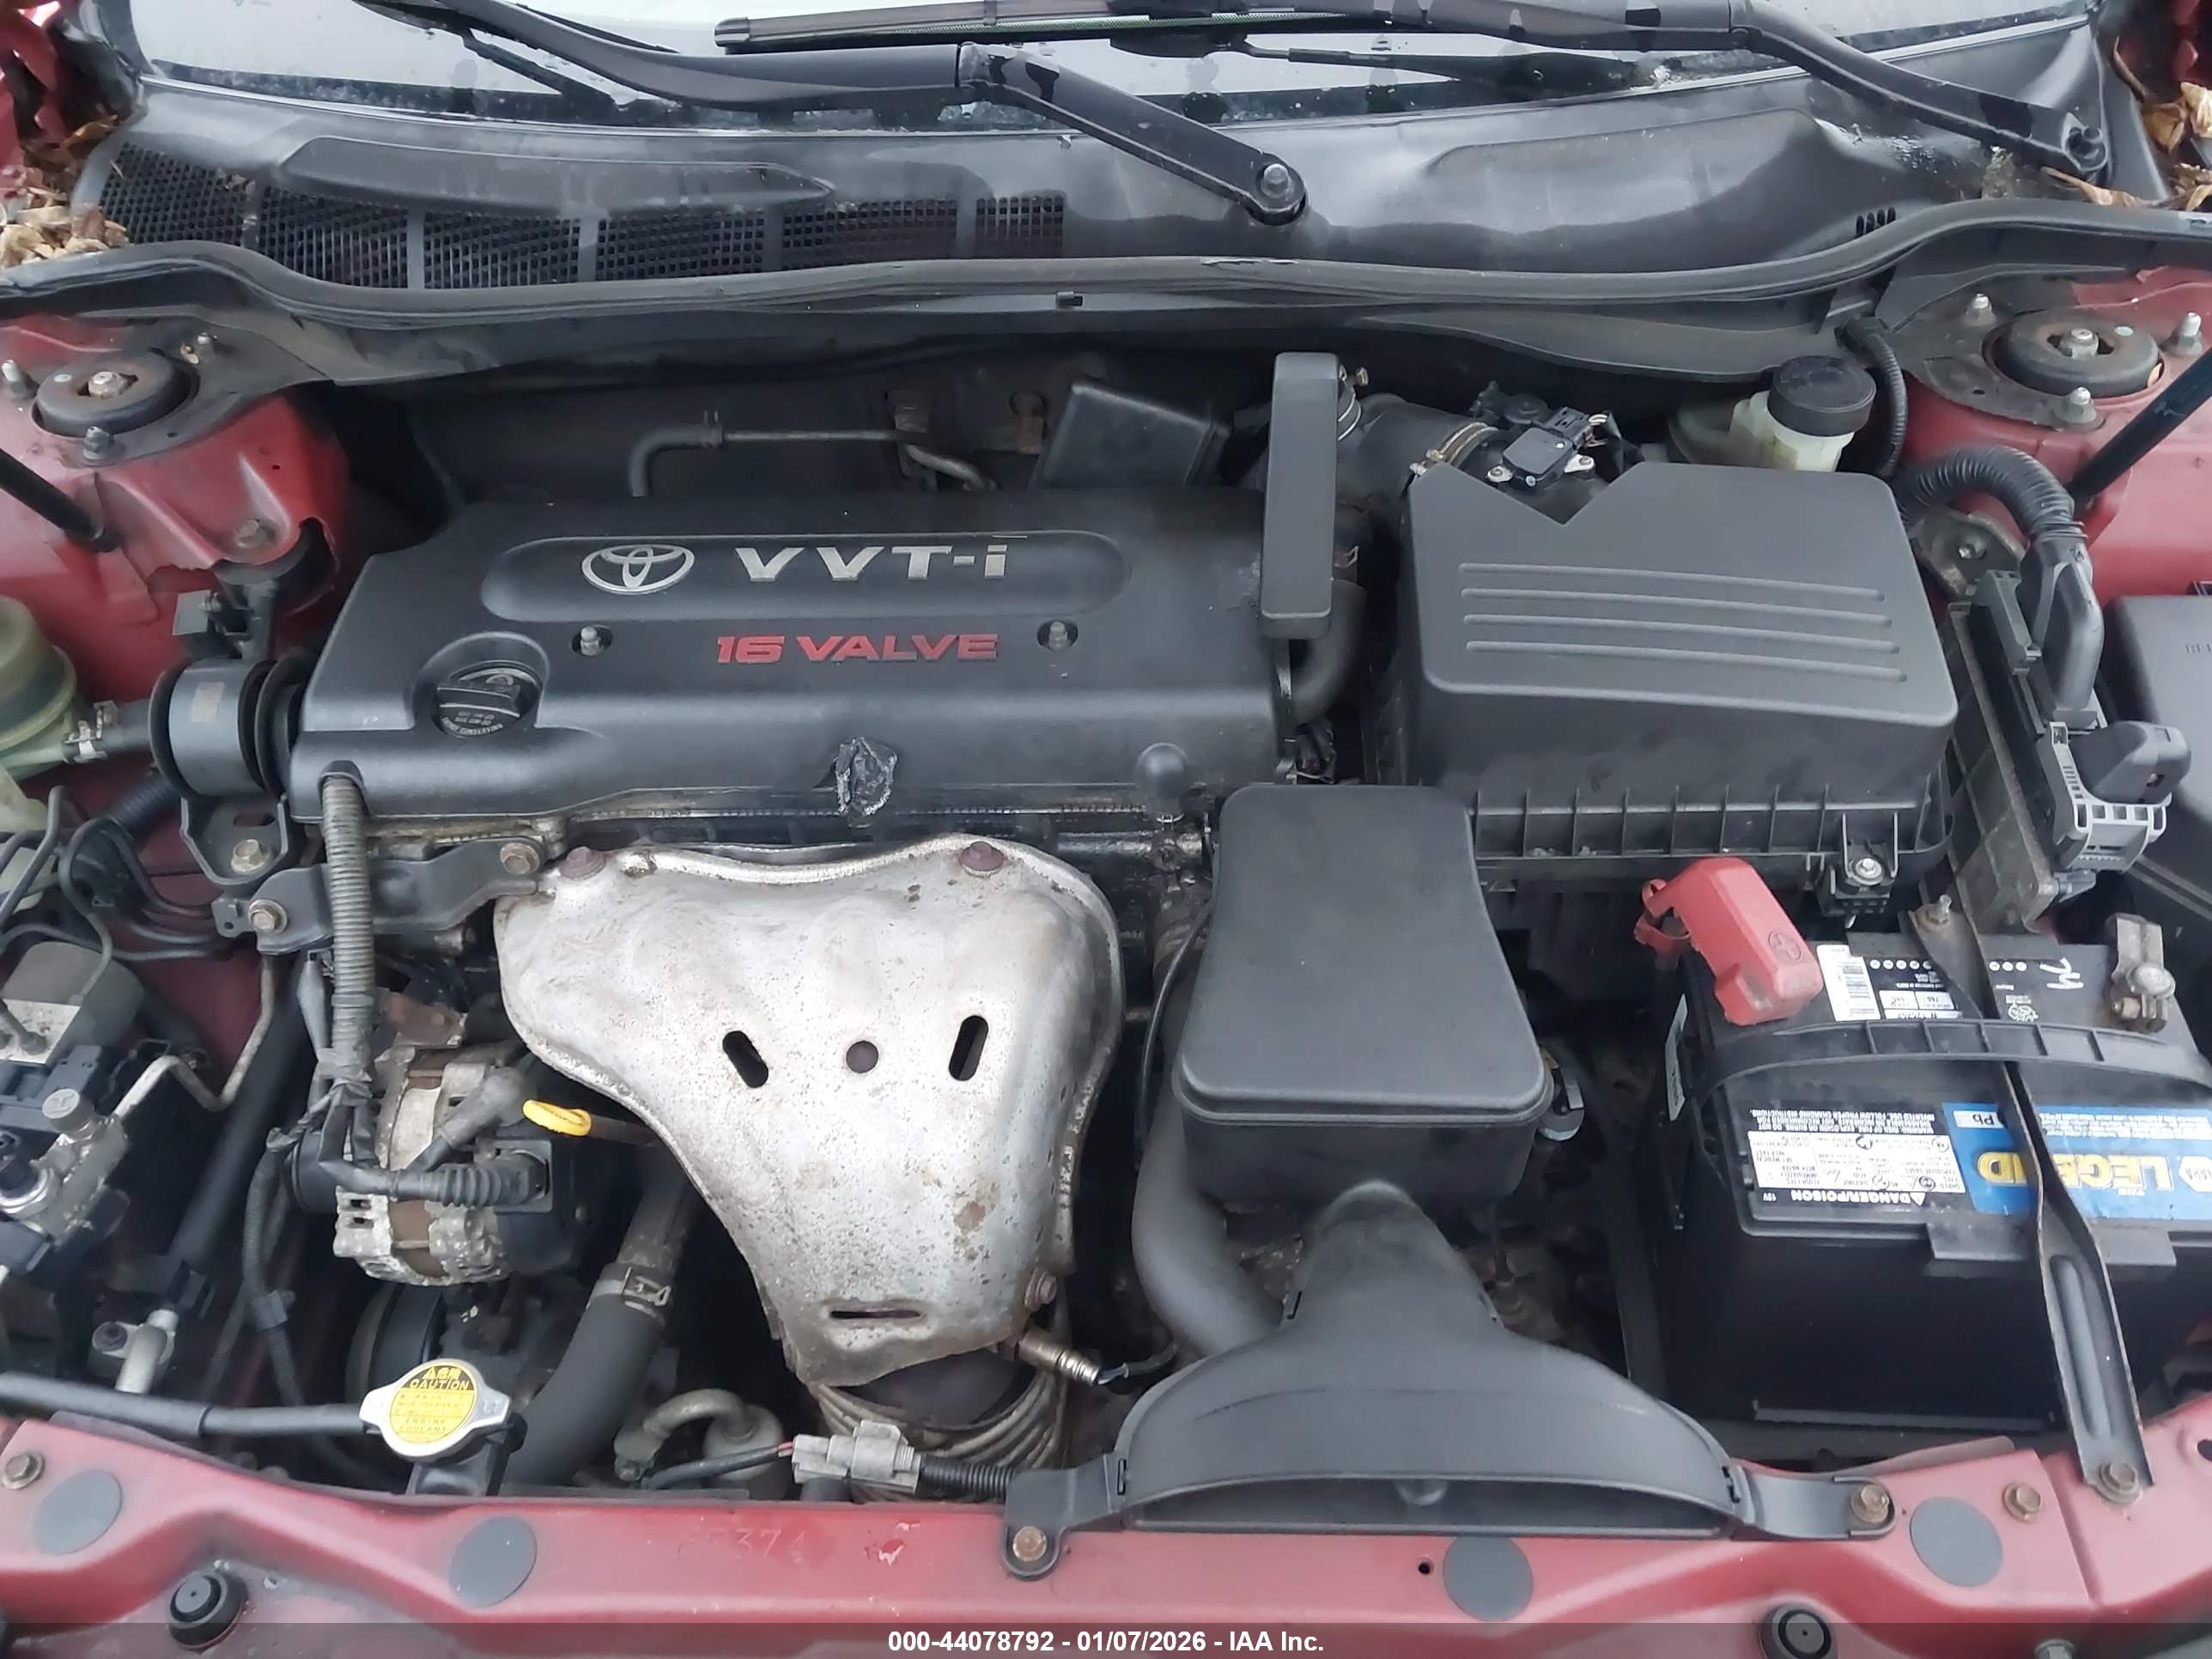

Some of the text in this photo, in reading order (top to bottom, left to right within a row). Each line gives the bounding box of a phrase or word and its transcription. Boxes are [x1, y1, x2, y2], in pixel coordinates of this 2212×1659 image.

[735, 545, 1008, 582] VVT-i
[718, 634, 999, 664] 16 VALVE
[1972, 1114, 1994, 1127] Pb
[1763, 1192, 1777, 1201] 12V
[2118, 1188, 2145, 1196] THE
[410, 1378, 470, 1391] CAUTION
